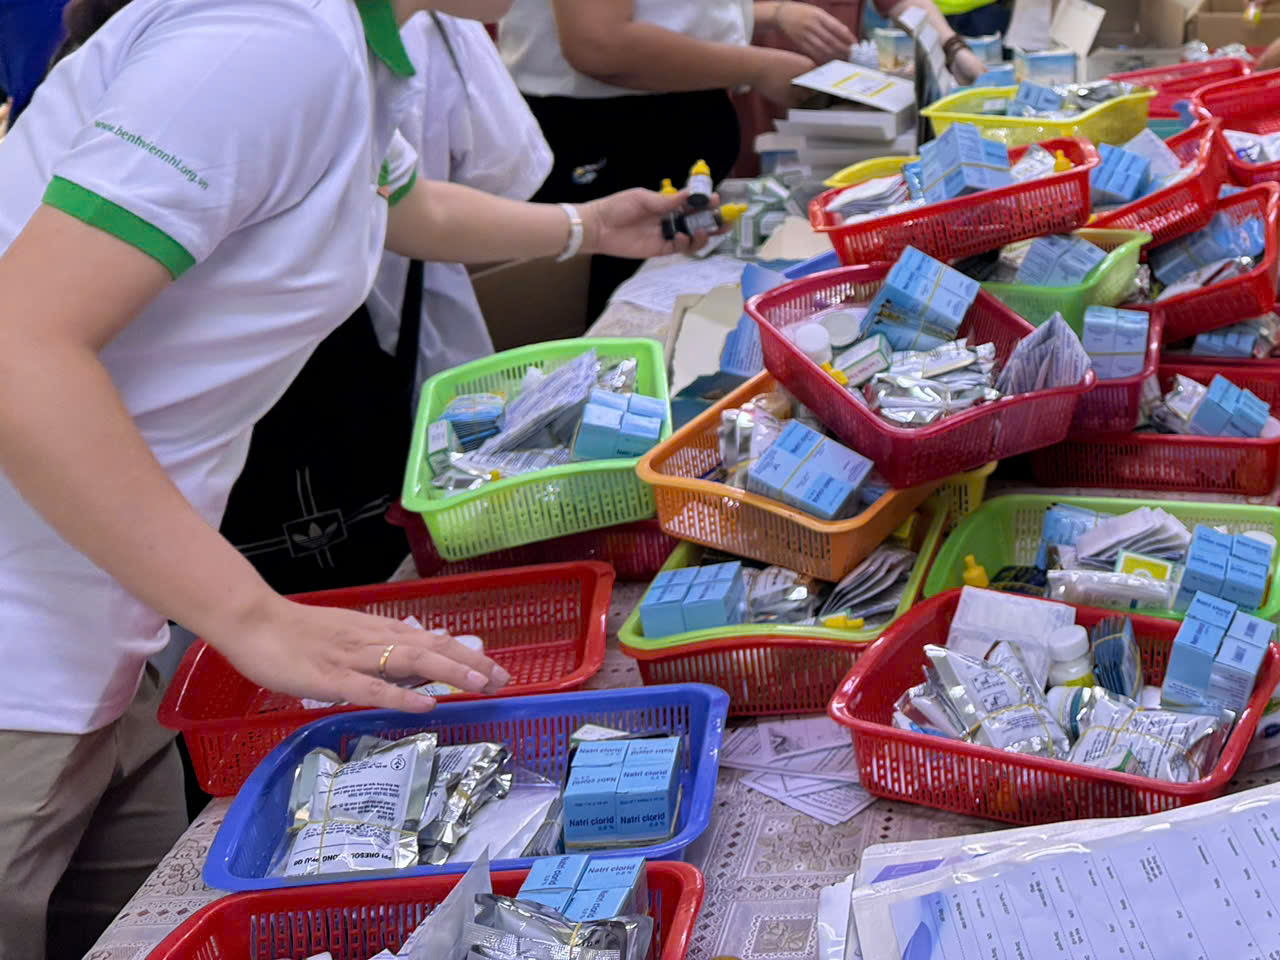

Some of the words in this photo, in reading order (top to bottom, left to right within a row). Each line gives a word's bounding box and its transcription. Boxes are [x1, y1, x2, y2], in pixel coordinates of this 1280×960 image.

[569, 818, 589, 827] Natri
[590, 815, 615, 825] clorid
[620, 814, 641, 825] Natri
[642, 812, 666, 821] clorid
[588, 866, 608, 874] Natri
[610, 864, 636, 872] clorid
